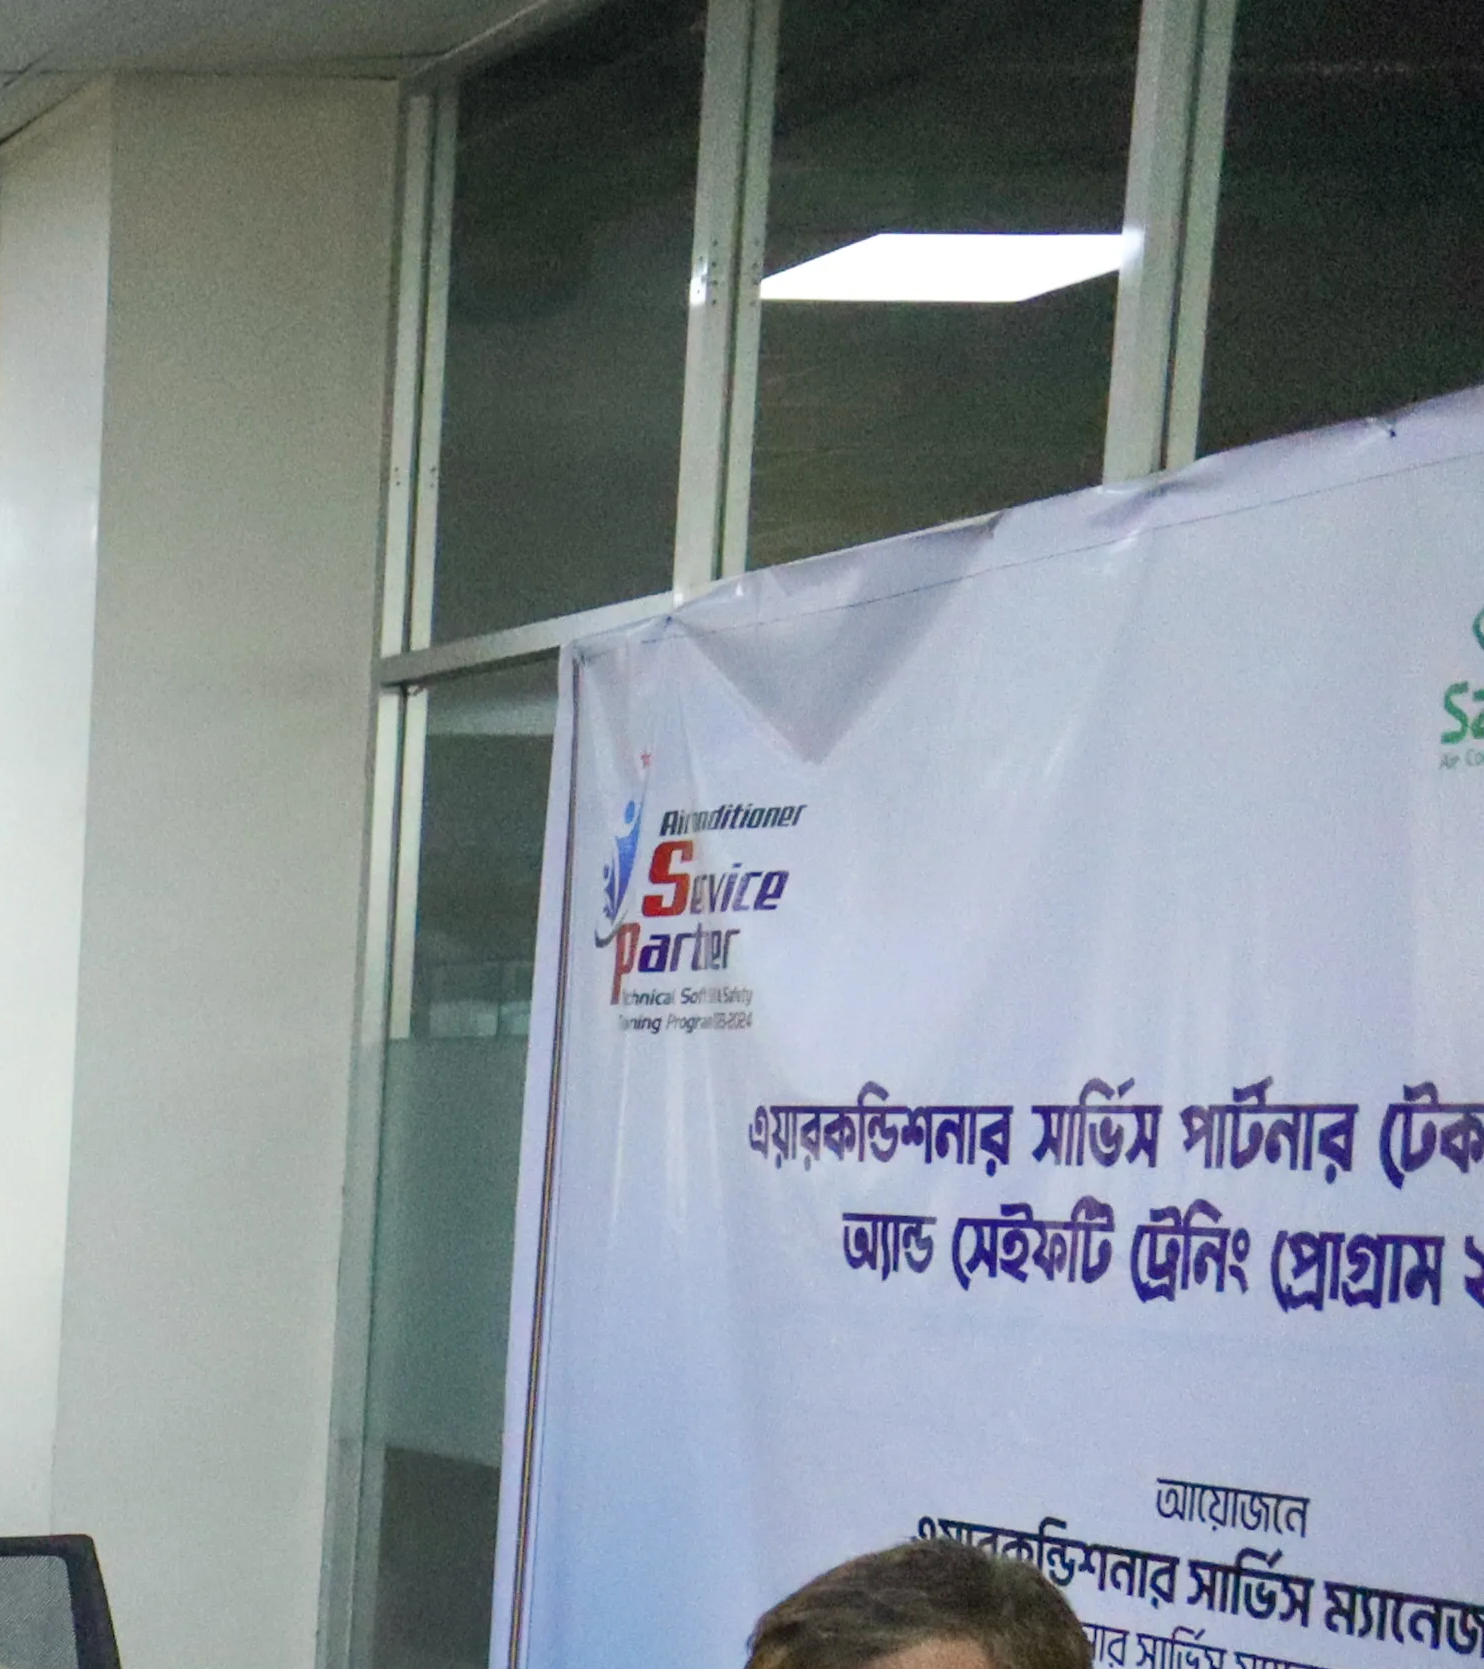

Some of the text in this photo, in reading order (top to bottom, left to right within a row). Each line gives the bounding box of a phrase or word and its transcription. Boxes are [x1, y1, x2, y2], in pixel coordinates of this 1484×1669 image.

[749, 1080, 1013, 1177] এয়ারকন্ডিশনার
[1031, 1077, 1163, 1167] সার্ভিস
[1179, 1075, 1359, 1185] পার্টনার
[952, 1195, 1114, 1291] সেইফটি
[1130, 1198, 1250, 1304] ট্রেনিং
[1270, 1230, 1446, 1313] প্রোগ্রাম
[1156, 1478, 1311, 1538] আয়োজনে
[1187, 1548, 1315, 1627] সার্ভিস
